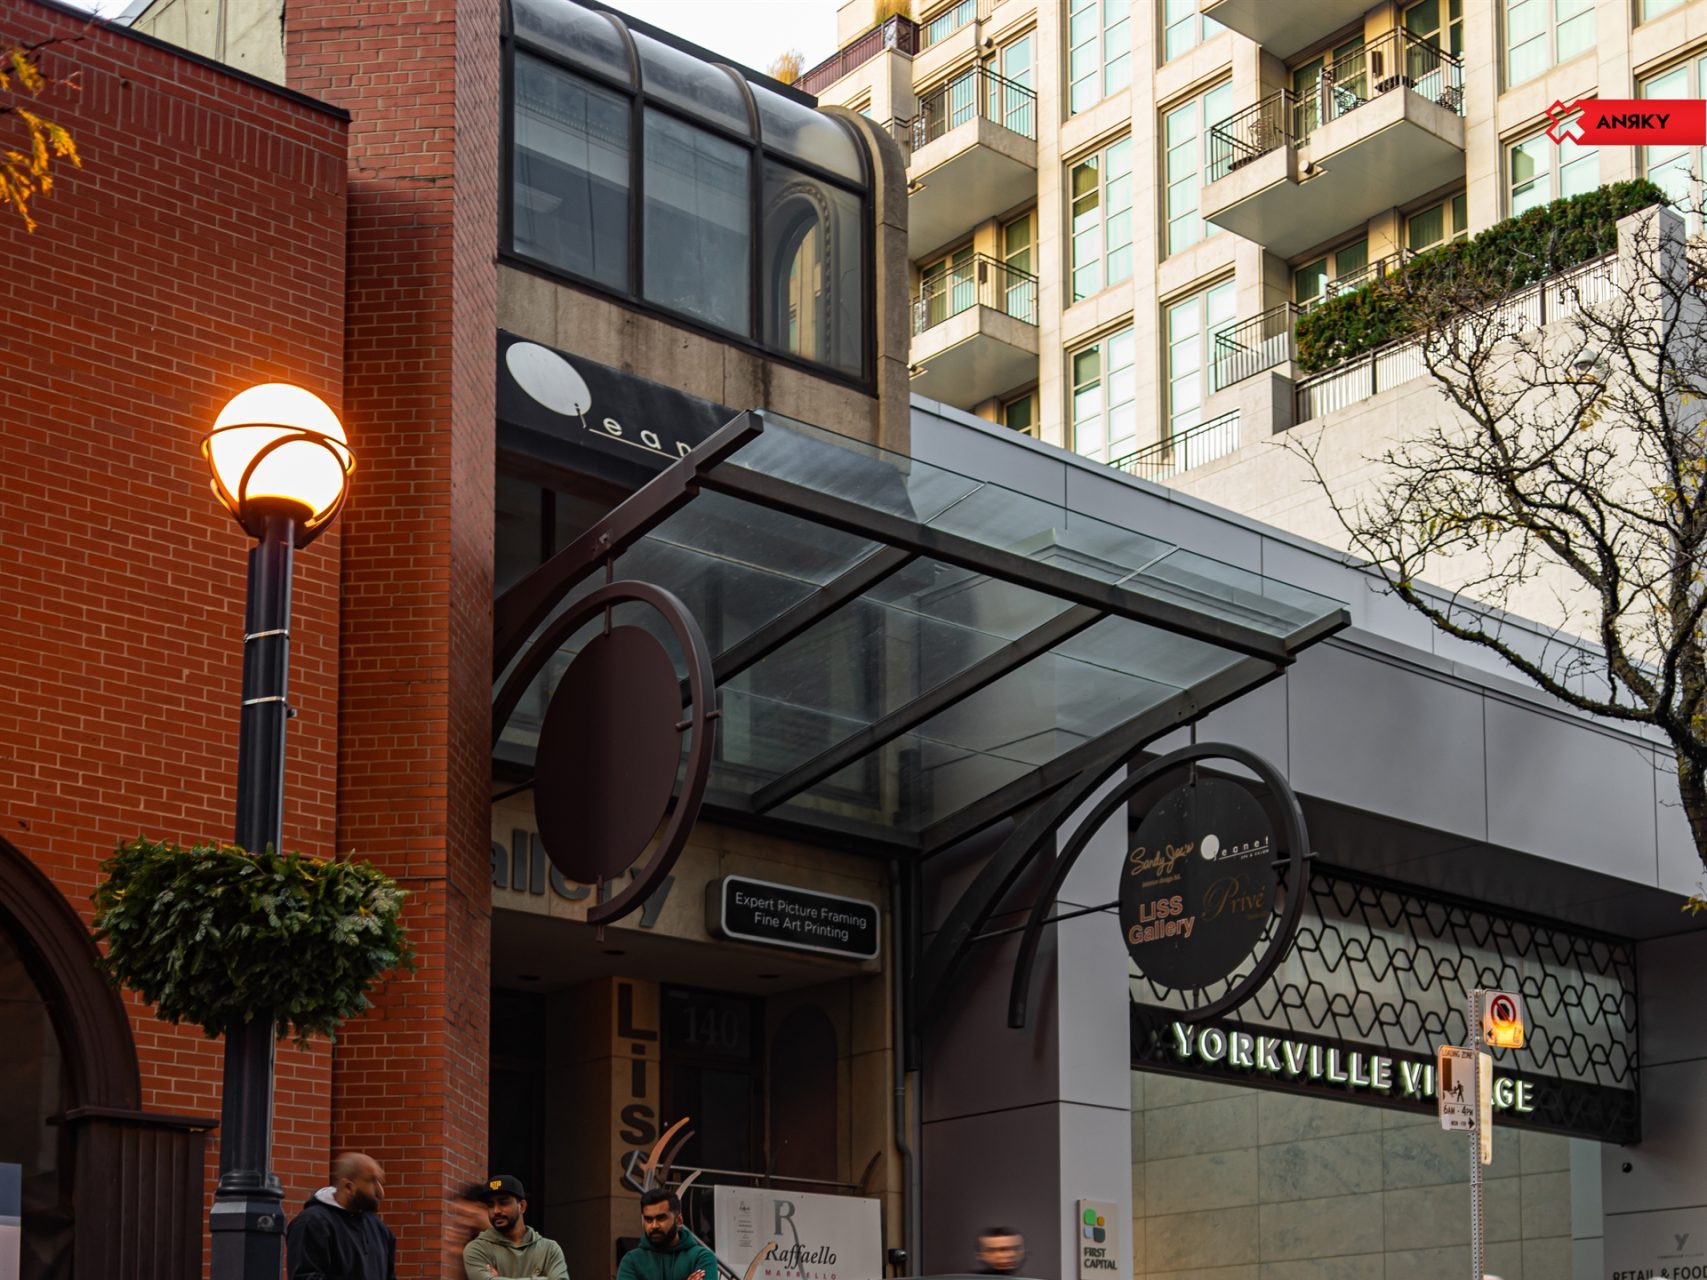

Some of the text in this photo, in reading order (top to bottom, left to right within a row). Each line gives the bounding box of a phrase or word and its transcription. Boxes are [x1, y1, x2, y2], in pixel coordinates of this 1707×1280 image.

[735, 892, 867, 929] Expert Picture Framing
[1139, 895, 1183, 923] LISS
[754, 912, 849, 942] Fine Art Printing
[1128, 916, 1195, 945] Gallery
[682, 1006, 739, 1049] 140
[1172, 1022, 1535, 1112] YORKVILLE VIGE
[765, 1244, 837, 1270] Raffaello
[1084, 1247, 1106, 1257] FIRST
[1084, 1258, 1117, 1270] CAPITAL
